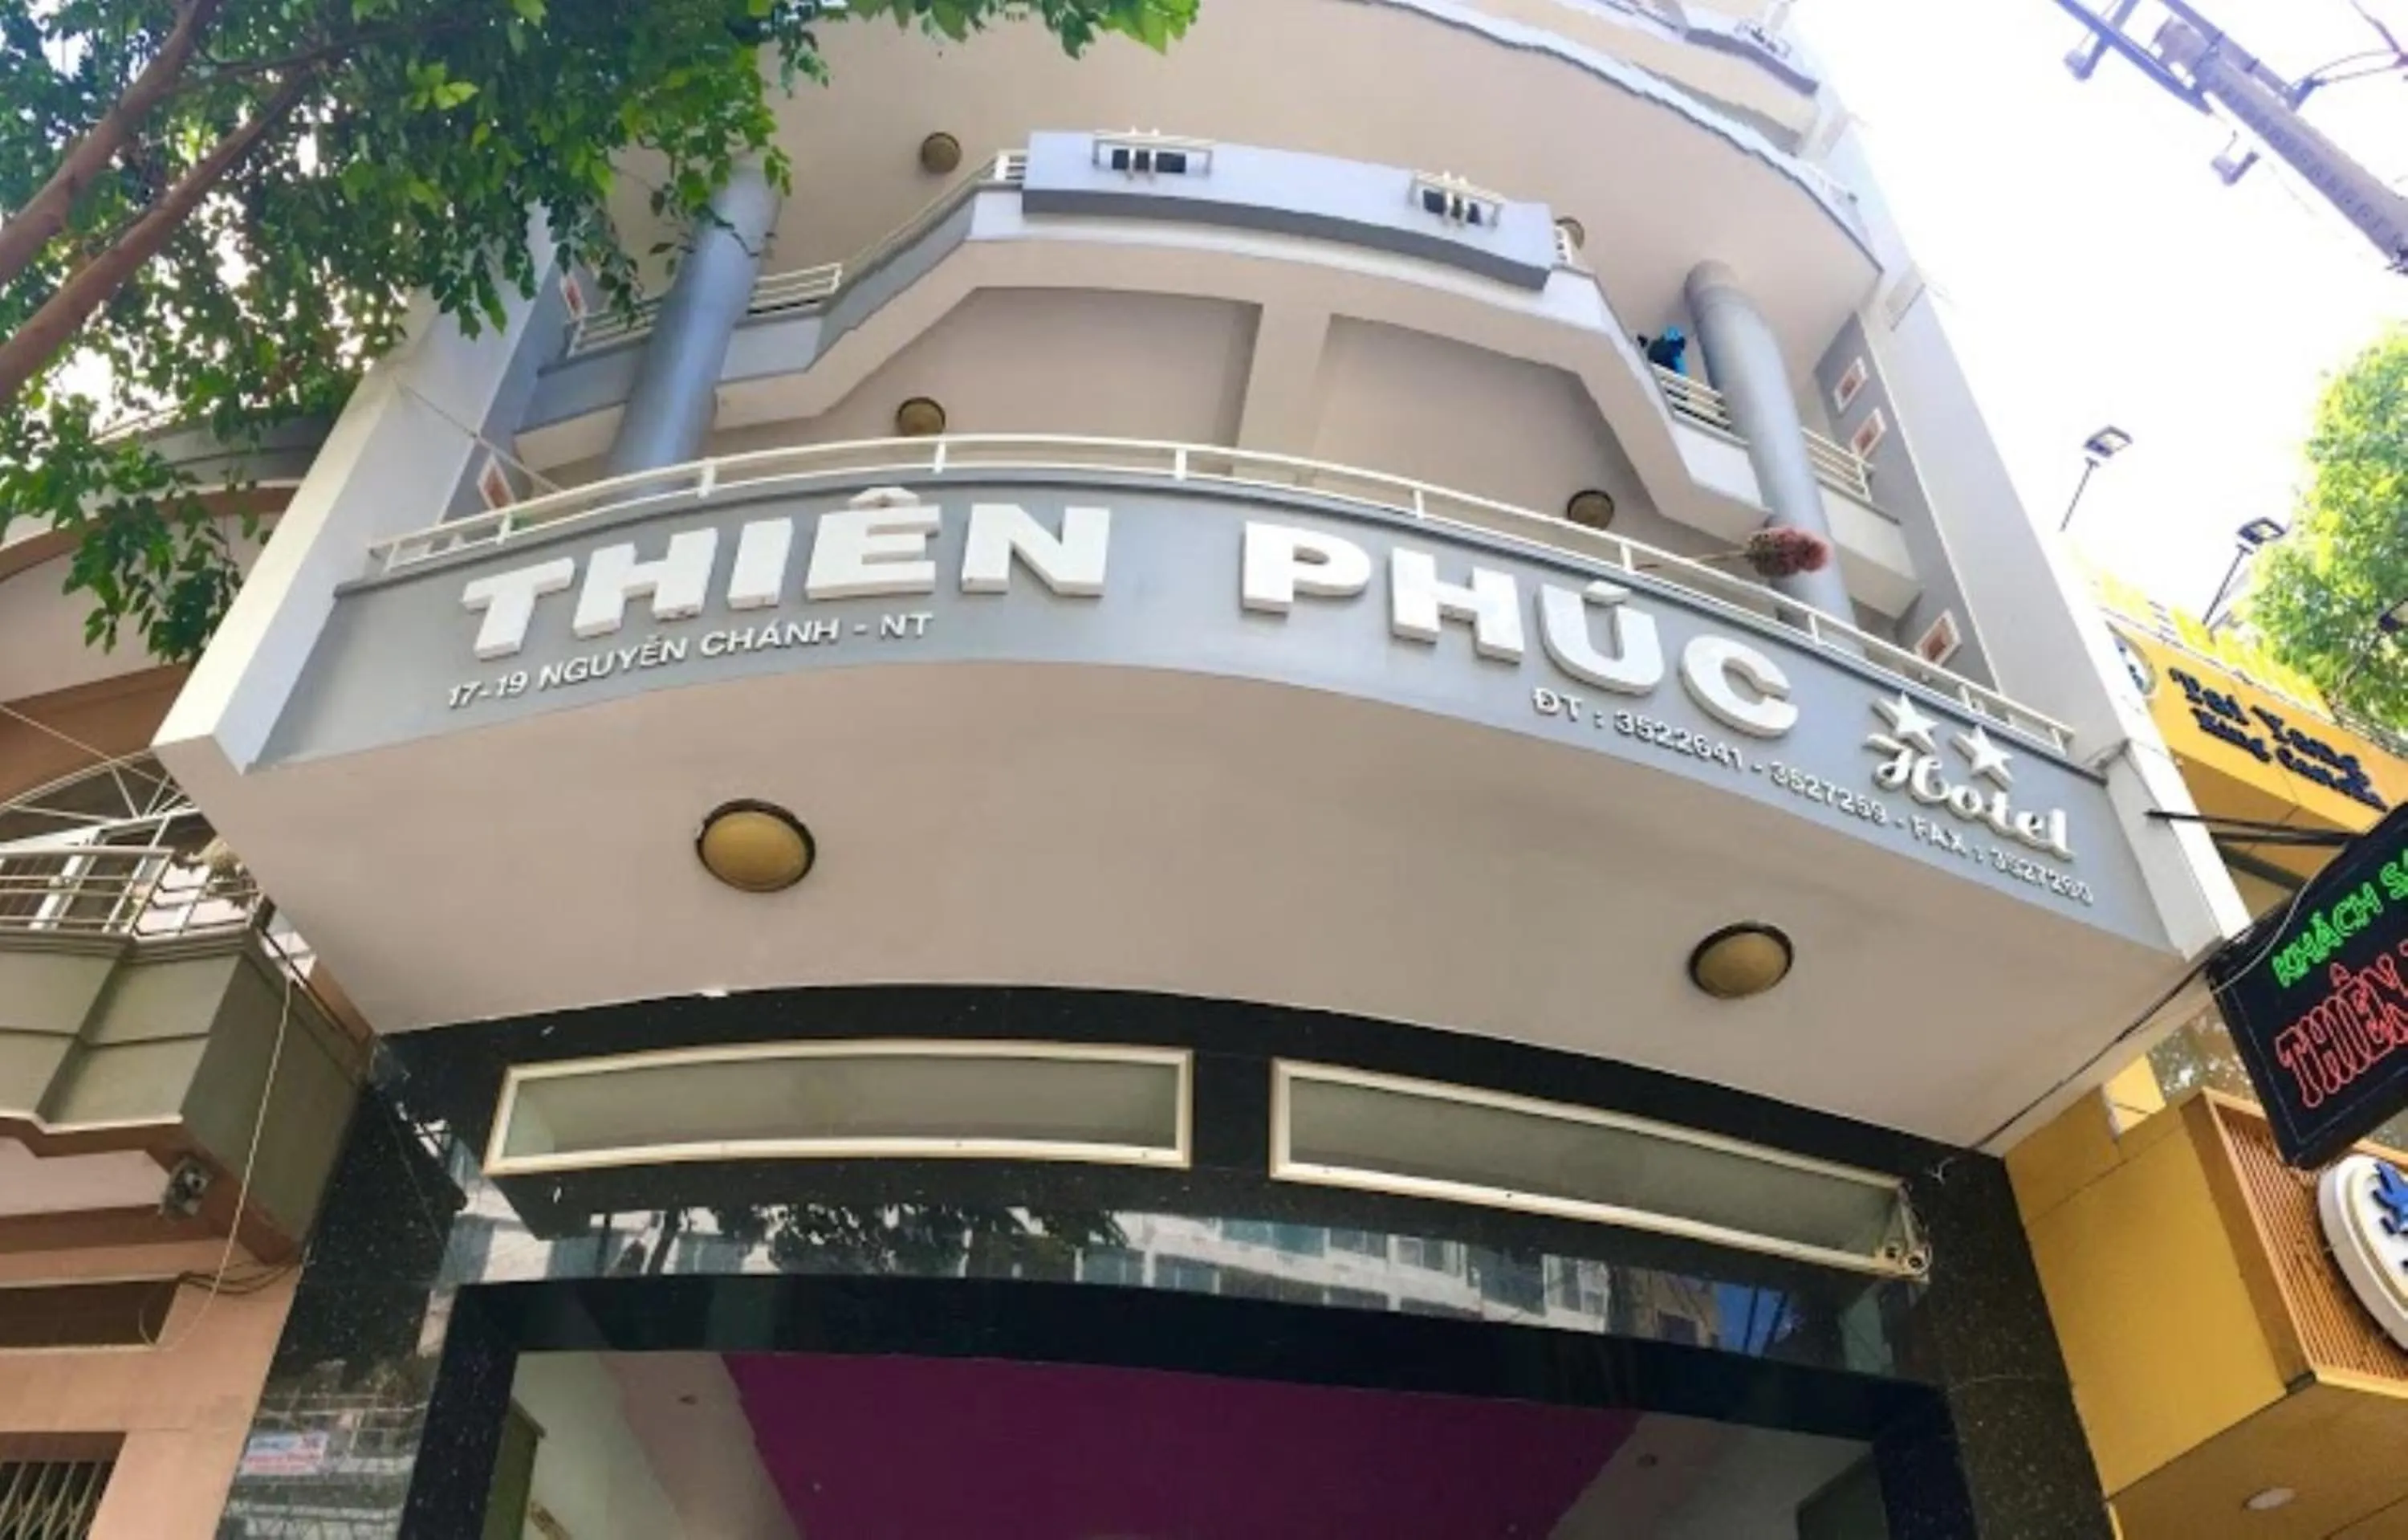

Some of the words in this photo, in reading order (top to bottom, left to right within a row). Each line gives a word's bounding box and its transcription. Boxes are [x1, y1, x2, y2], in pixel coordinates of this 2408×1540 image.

[448, 671, 529, 709] 17-19
[700, 616, 840, 657] CHÁNH
[880, 611, 934, 638] NT
[461, 487, 1111, 661] THIÊN
[1241, 520, 1800, 739] PHÚC
[1532, 687, 1583, 722] ĐT
[1910, 813, 1968, 858] FAX
[1861, 731, 2076, 862] Hotel
